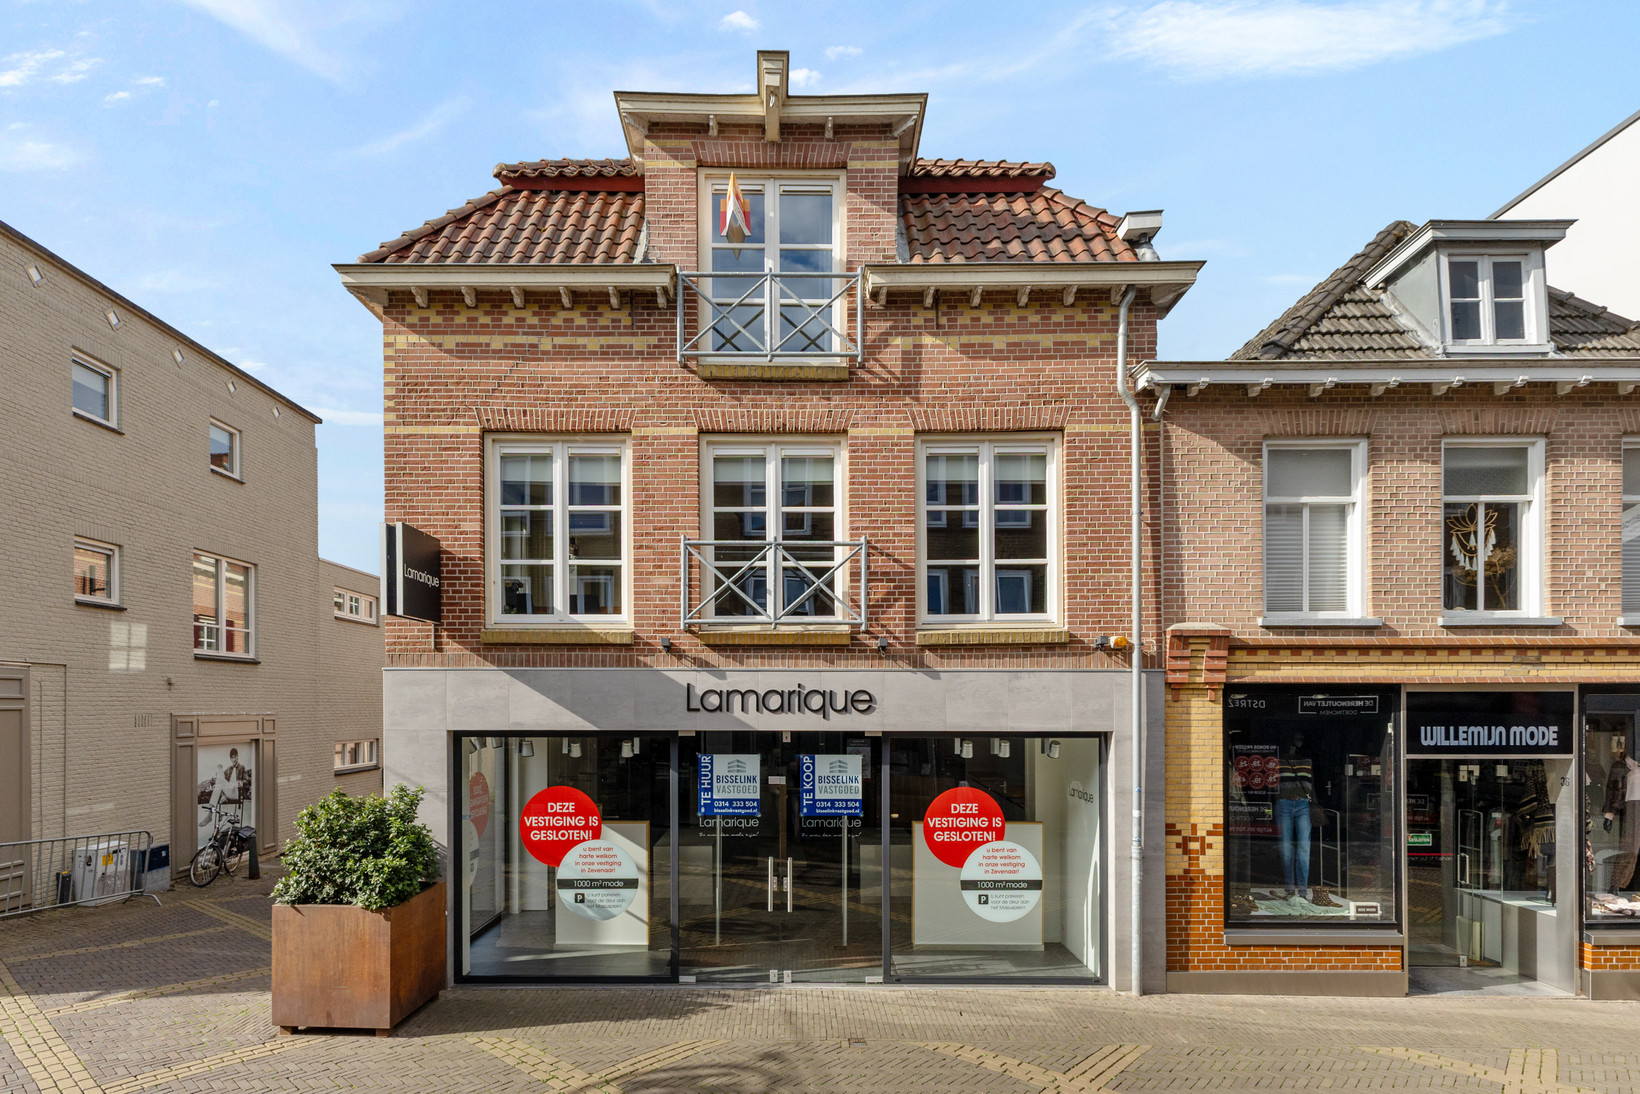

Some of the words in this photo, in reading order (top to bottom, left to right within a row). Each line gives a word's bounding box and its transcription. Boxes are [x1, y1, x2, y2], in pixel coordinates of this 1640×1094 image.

[403, 563, 440, 588] Lamarique
[686, 682, 874, 721] Lamarique
[1420, 725, 1507, 747] WILLEMIJN
[1509, 725, 1559, 747] MODE
[701, 755, 711, 788] HUUR
[803, 756, 813, 789] KOOP
[716, 775, 758, 784] BISSELINK
[817, 775, 860, 785] BISSELINK
[1560, 776, 1570, 787] 36
[716, 785, 758, 794] VASTGOED
[818, 785, 860, 795] VASTGOED
[701, 791, 711, 806] TE
[803, 792, 813, 806] TE
[547, 802, 576, 813] DEZE
[950, 803, 979, 814] DEZE
[524, 816, 586, 827] VESTIGING
[589, 816, 599, 827] IS
[699, 816, 760, 829] Lamarique
[927, 817, 989, 828] VESTIGING
[992, 817, 1002, 828] IS
[530, 830, 593, 841] GESLOTEN!
[933, 831, 996, 842] GESLOTEN!
